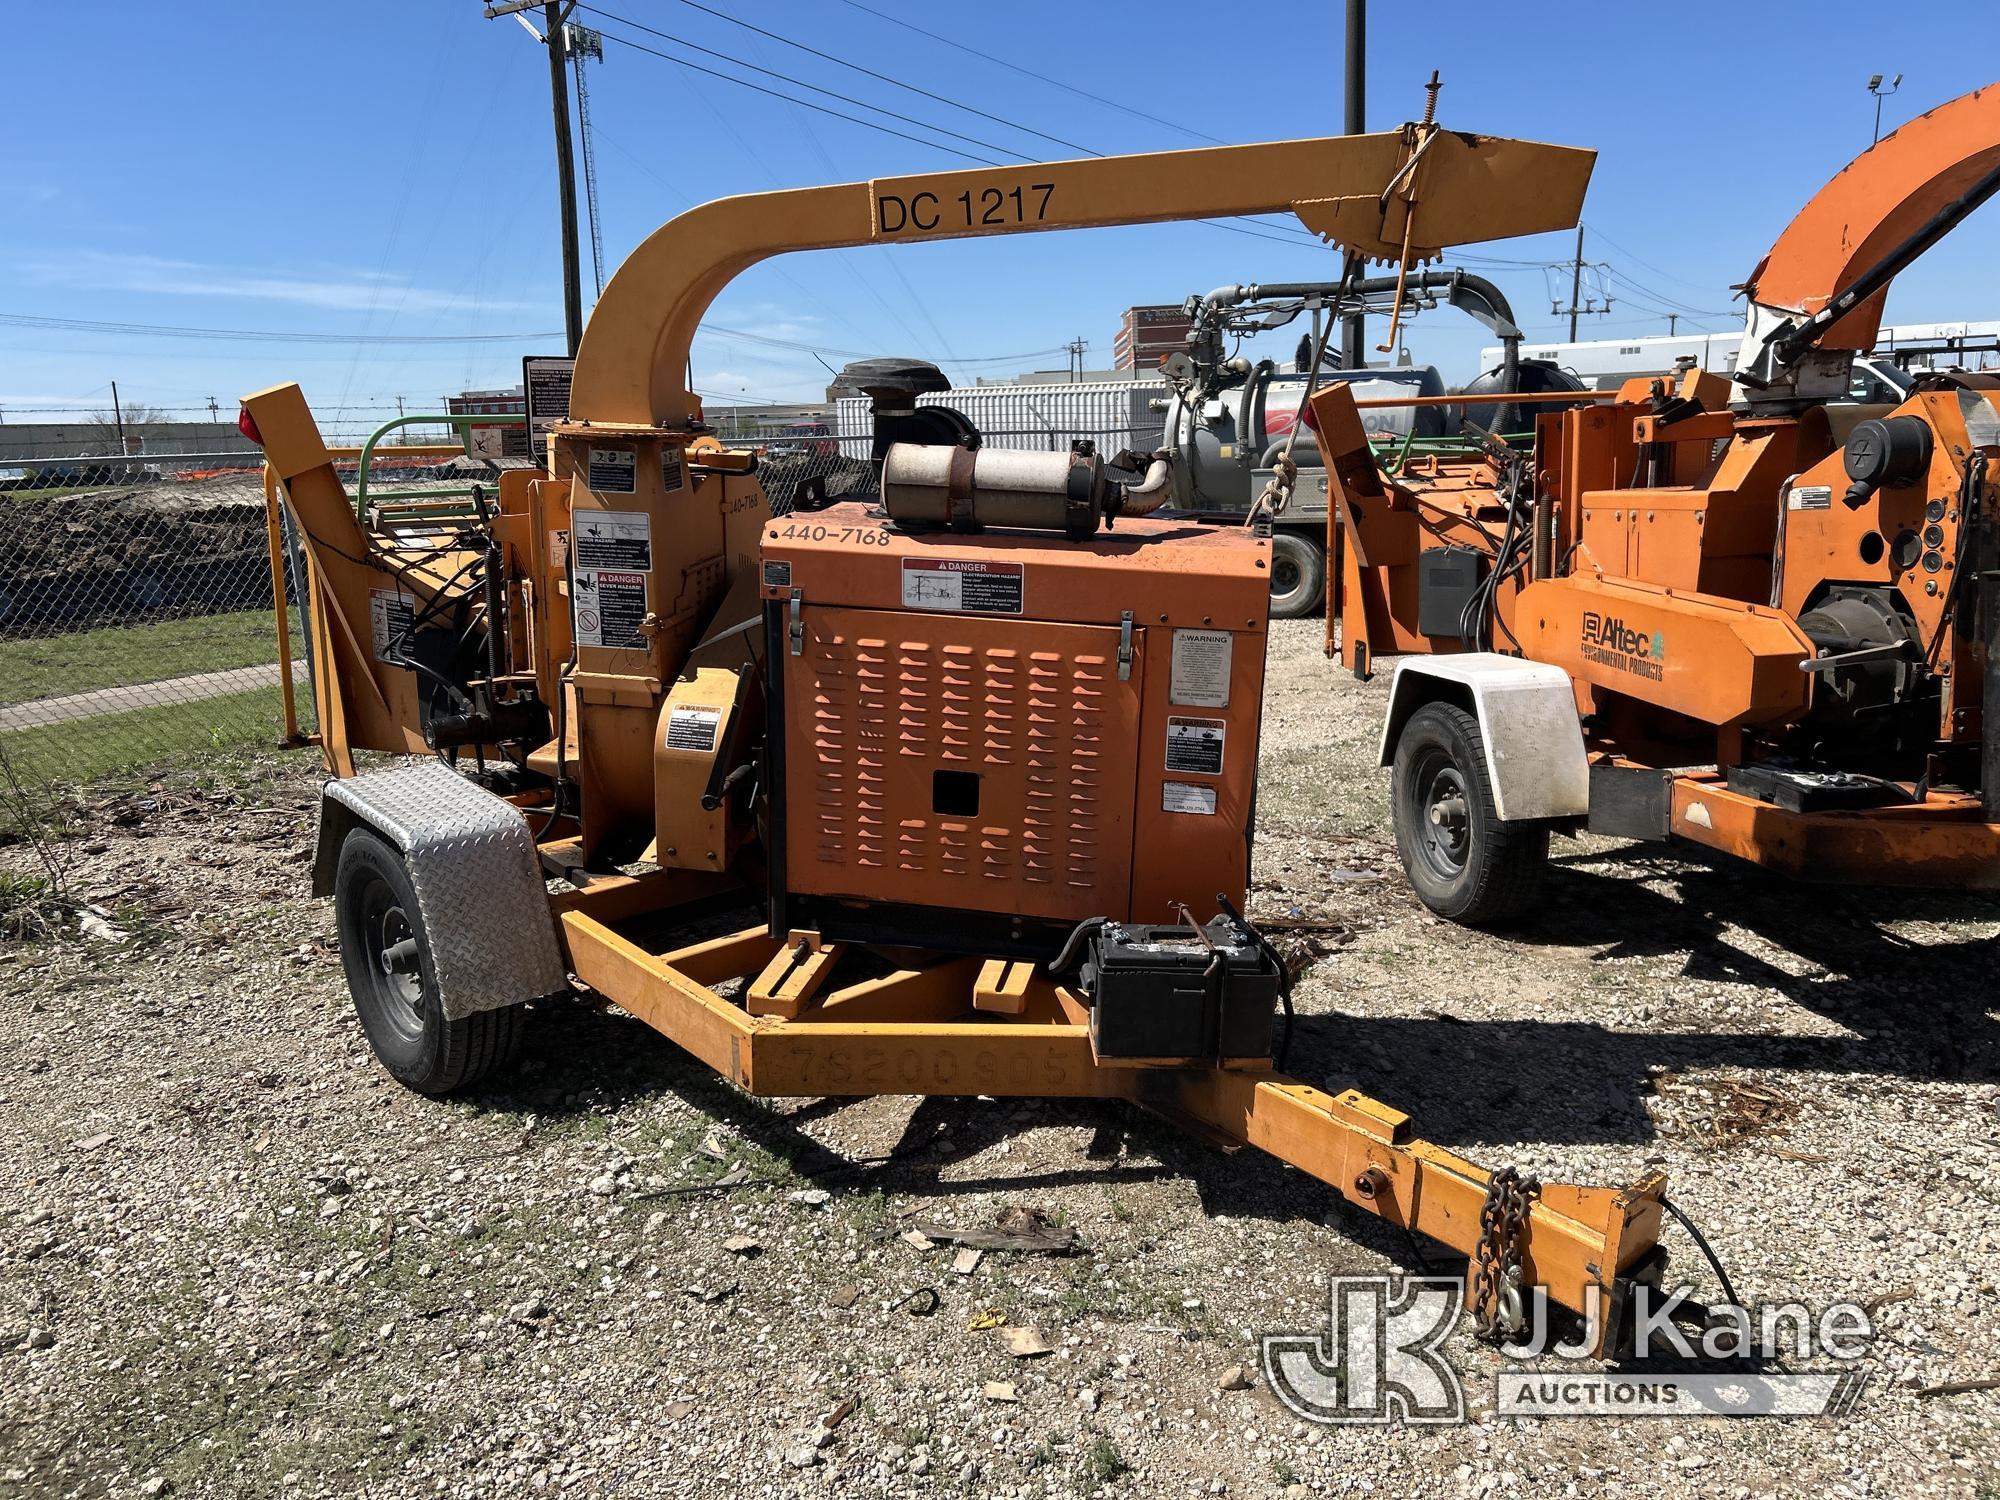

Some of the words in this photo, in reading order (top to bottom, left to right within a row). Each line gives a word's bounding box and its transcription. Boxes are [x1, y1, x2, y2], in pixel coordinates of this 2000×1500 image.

[878, 191, 941, 233] DC
[957, 183, 1055, 226] 1217
[781, 524, 891, 547] 440-7168
[948, 562, 987, 572] DANGER
[608, 574, 643, 584] DANGER
[1186, 635, 1228, 644] WARNING
[1600, 616, 1649, 658] Altec
